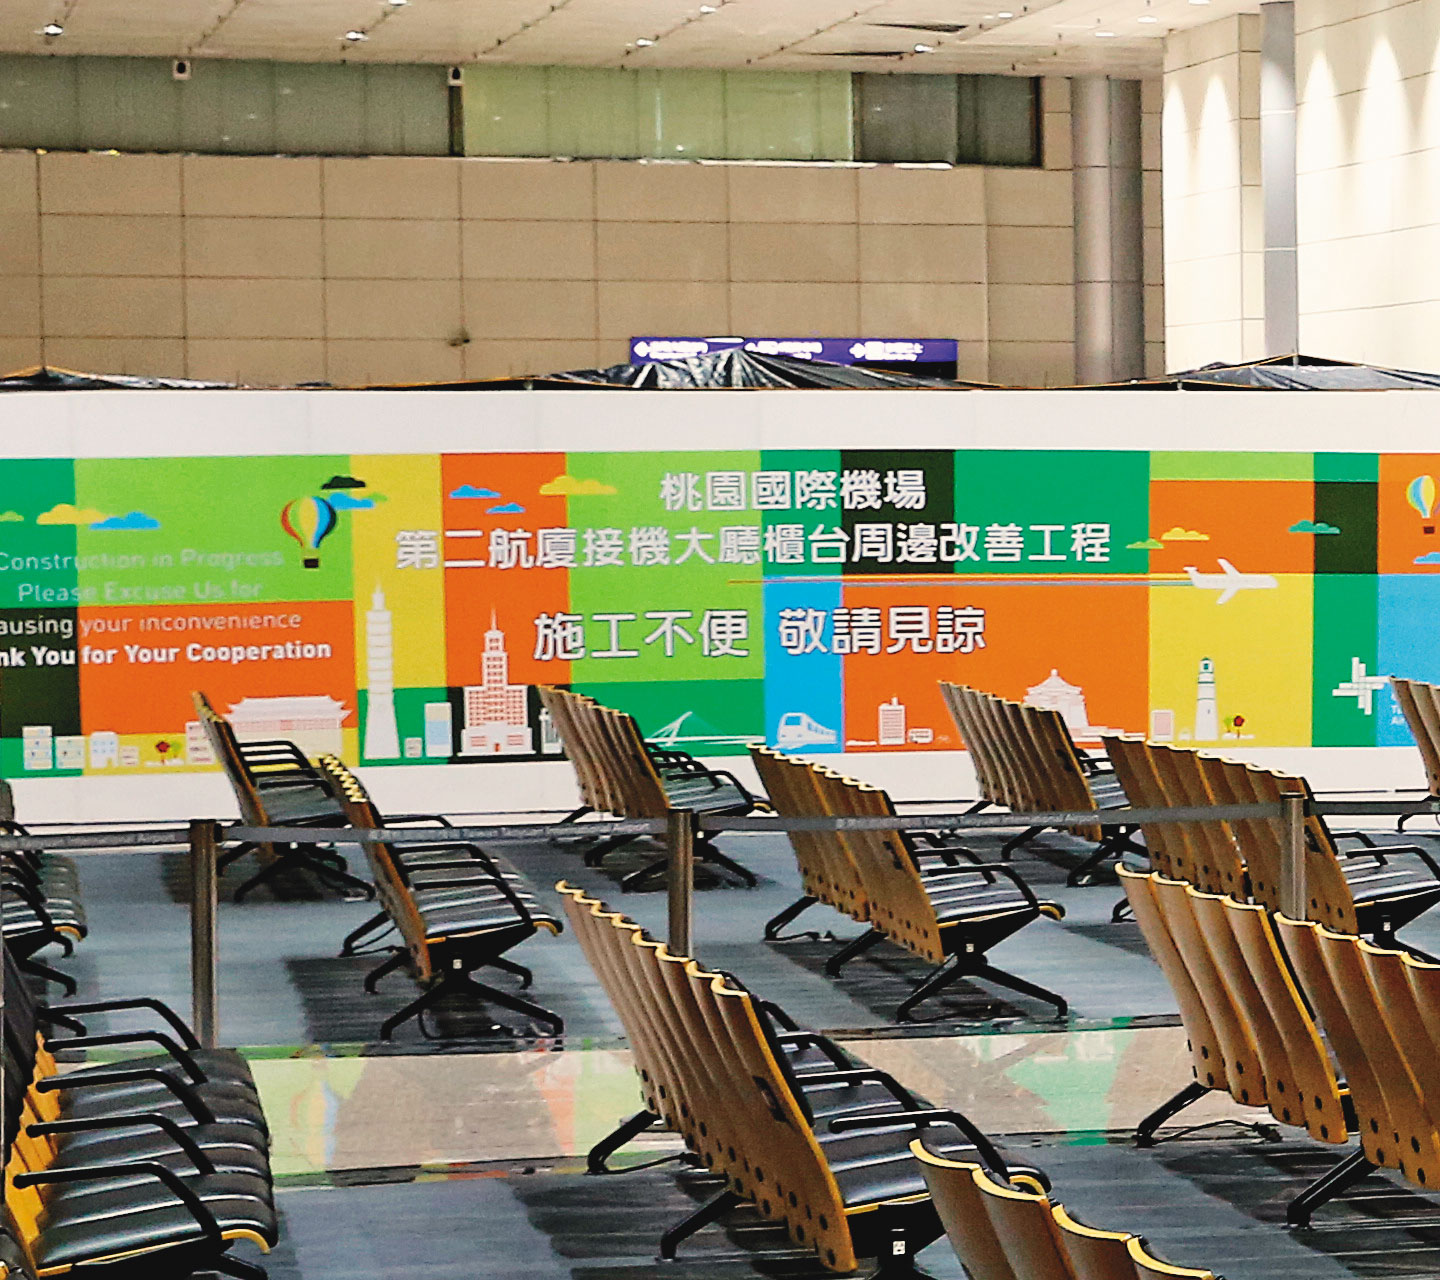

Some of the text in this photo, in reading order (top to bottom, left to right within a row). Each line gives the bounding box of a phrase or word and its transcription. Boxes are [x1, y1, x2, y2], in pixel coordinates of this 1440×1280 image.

[659, 469, 927, 511] 桃園國際機場
[395, 522, 1111, 569] 第二航廈接機大廳櫃台周邊改善工程
[181, 548, 283, 570] Progress
[18, 580, 263, 602] Please Excuse Us for
[81, 618, 132, 637] your
[140, 612, 302, 632] inconvenience
[533, 605, 987, 660] 施工不便 敬請見諒
[31, 646, 75, 666] You
[82, 645, 118, 664] for
[124, 643, 180, 664] Your
[186, 641, 331, 664] Cooperation
